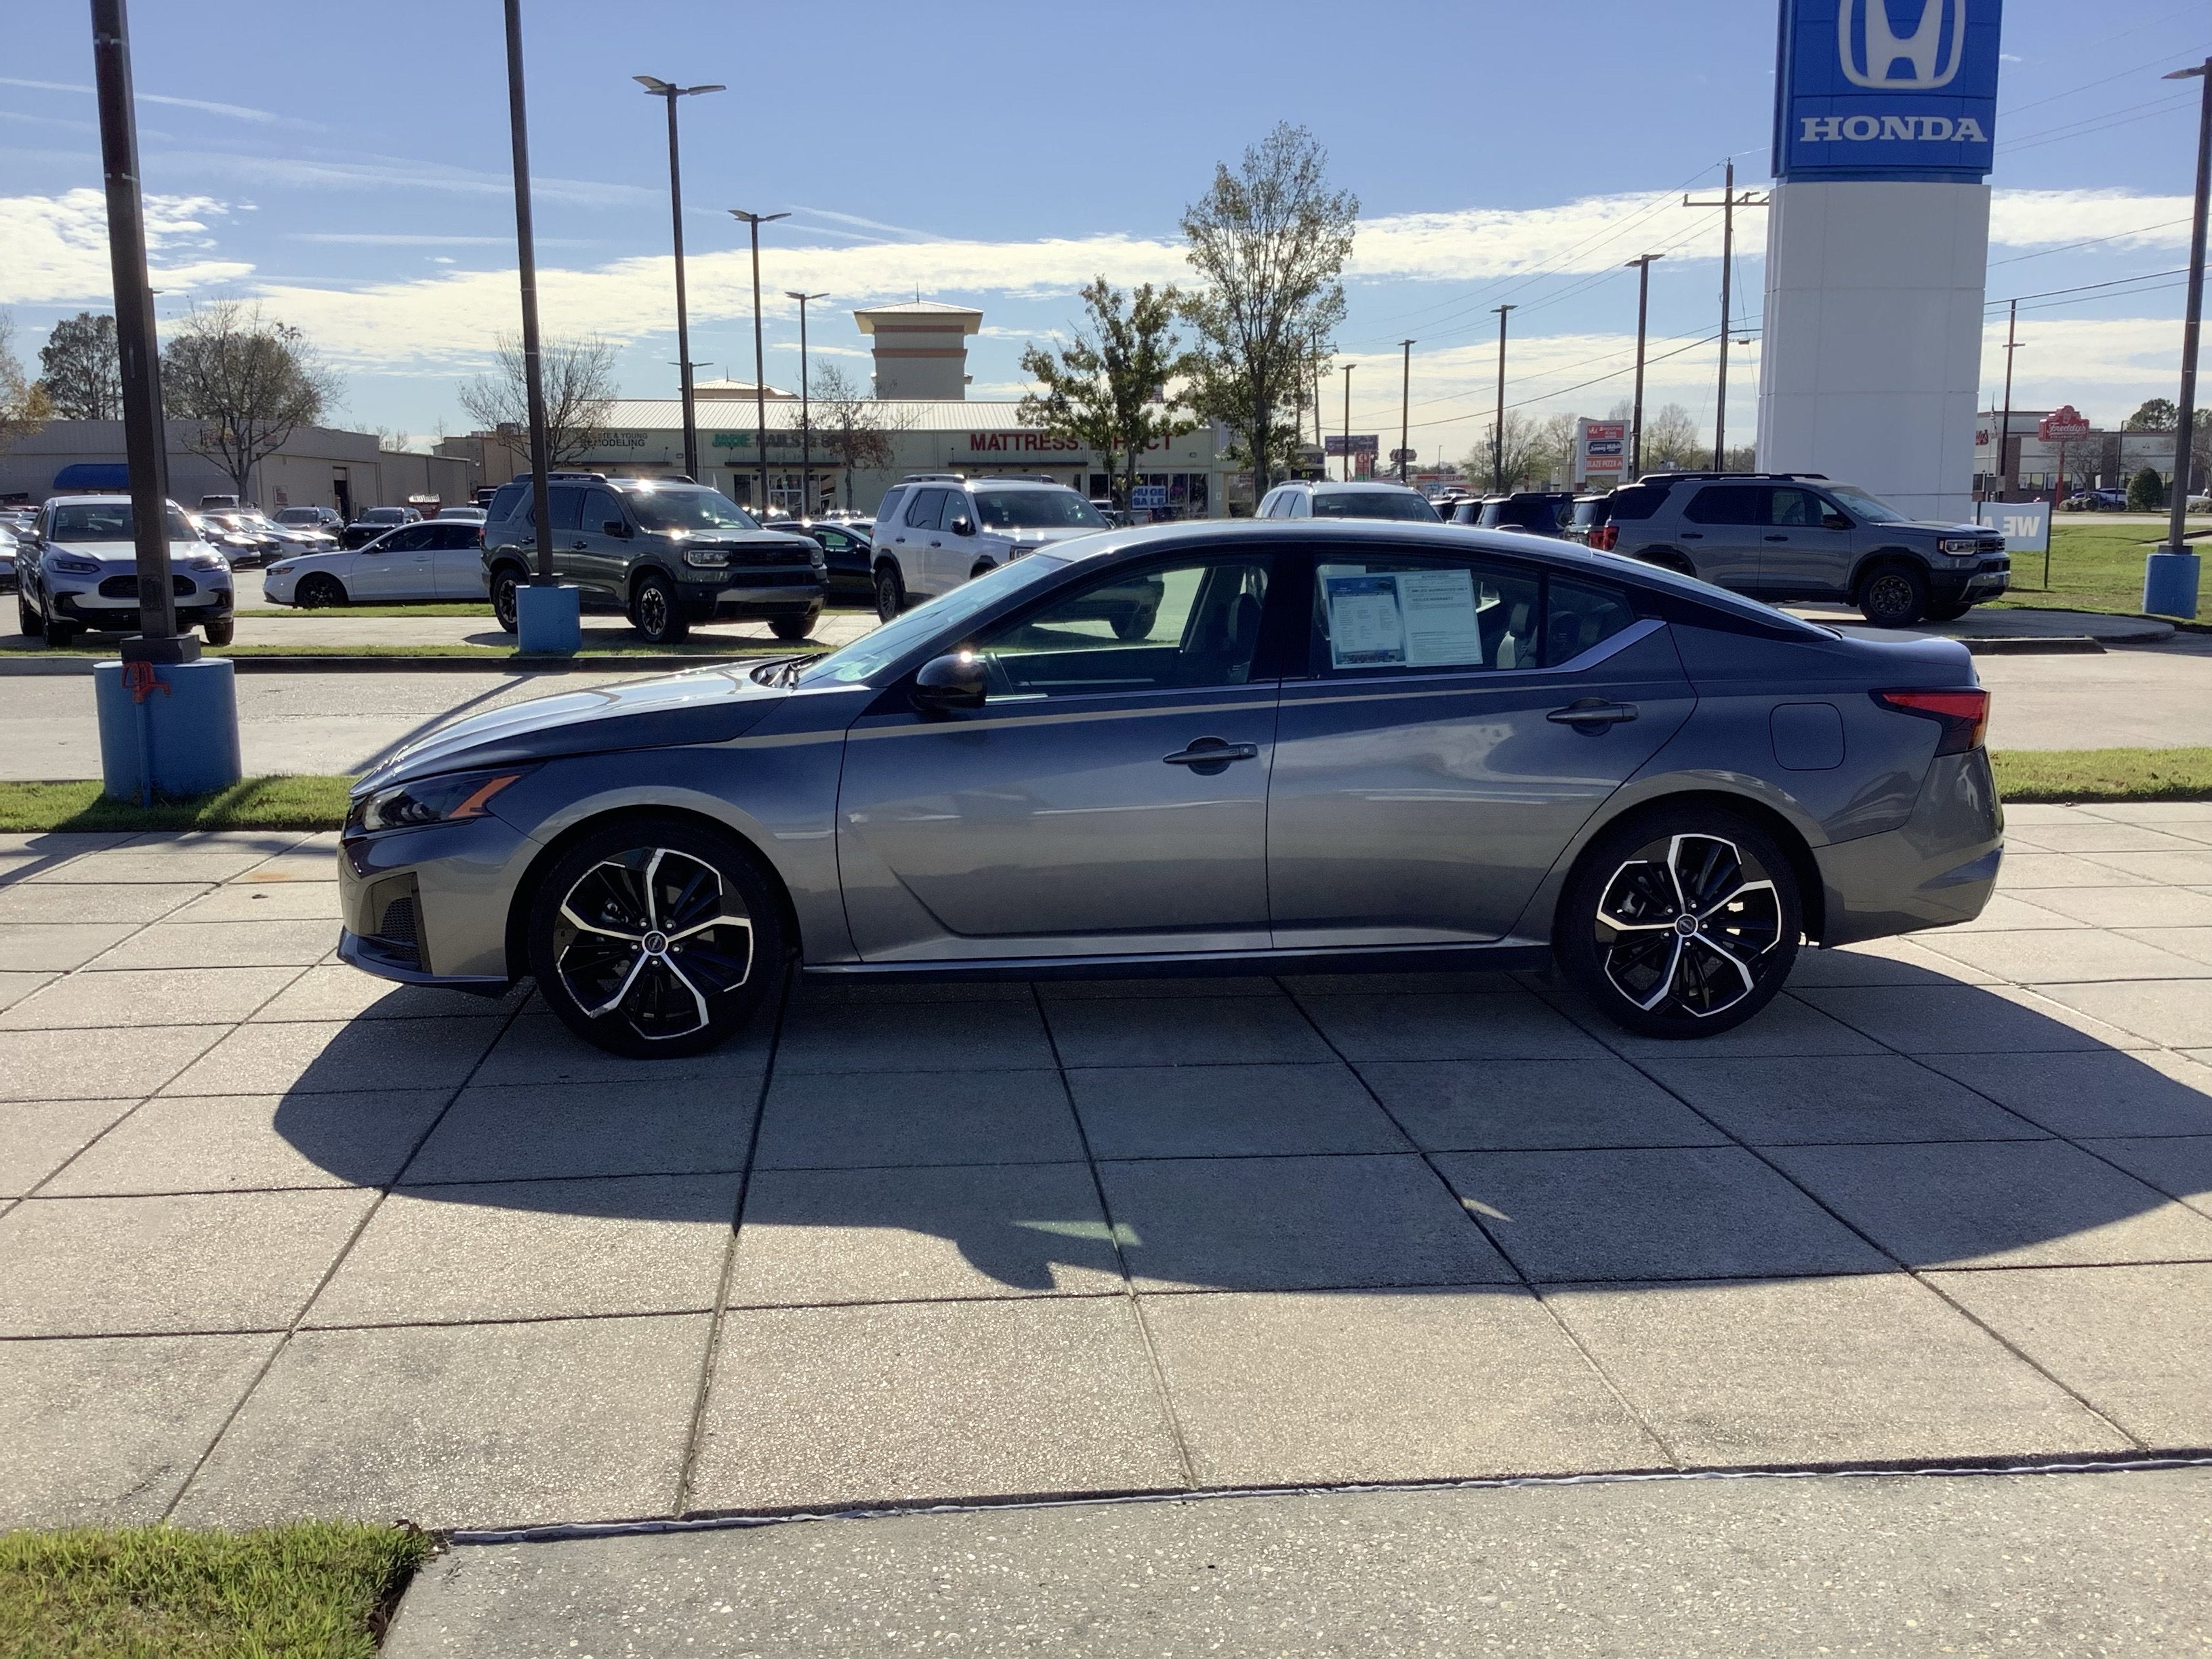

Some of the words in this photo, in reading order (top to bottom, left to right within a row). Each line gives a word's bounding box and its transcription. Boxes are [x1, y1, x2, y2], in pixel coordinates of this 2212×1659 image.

[1800, 116, 1988, 142] HONDA
[2047, 422, 2087, 433] Freddy's
[970, 433, 1080, 451] MATTRESS
[1134, 488, 1164, 496] HUGE
[1134, 497, 1164, 506] SALE
